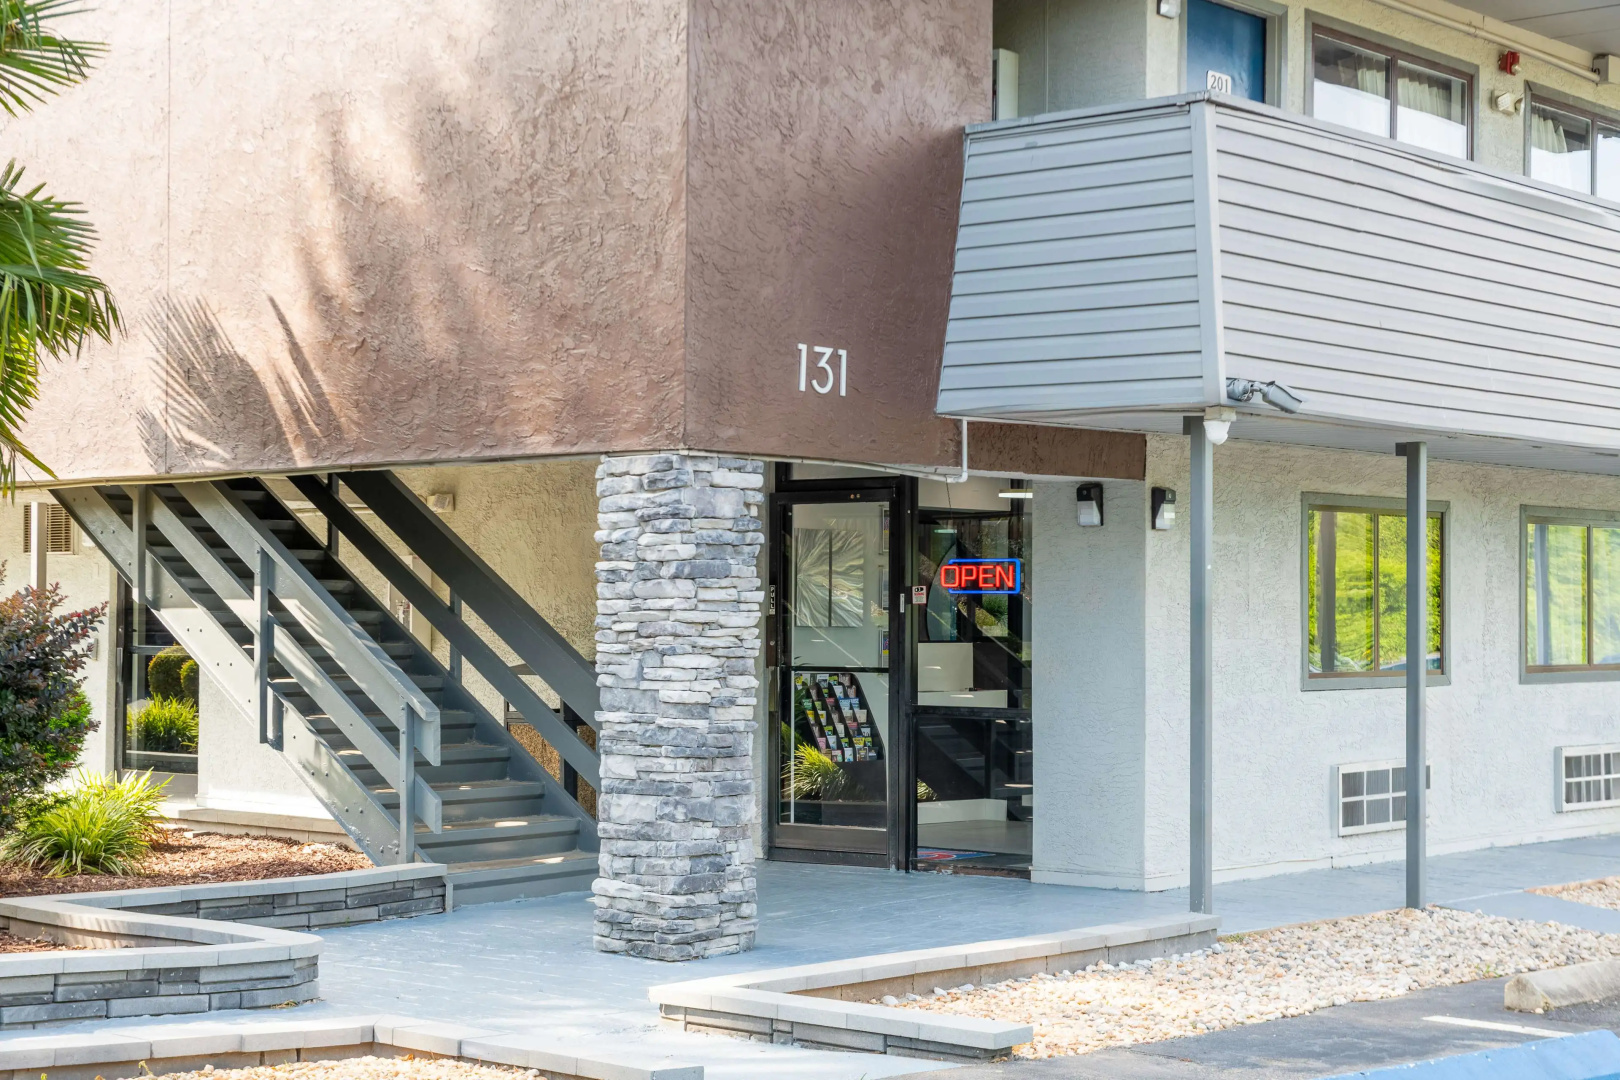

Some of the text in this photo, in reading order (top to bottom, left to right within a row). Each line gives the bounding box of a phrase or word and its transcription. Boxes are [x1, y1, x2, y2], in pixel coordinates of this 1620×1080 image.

[1211, 74, 1228, 93] 201
[797, 343, 847, 397] 131
[940, 564, 1015, 588] OPEN
